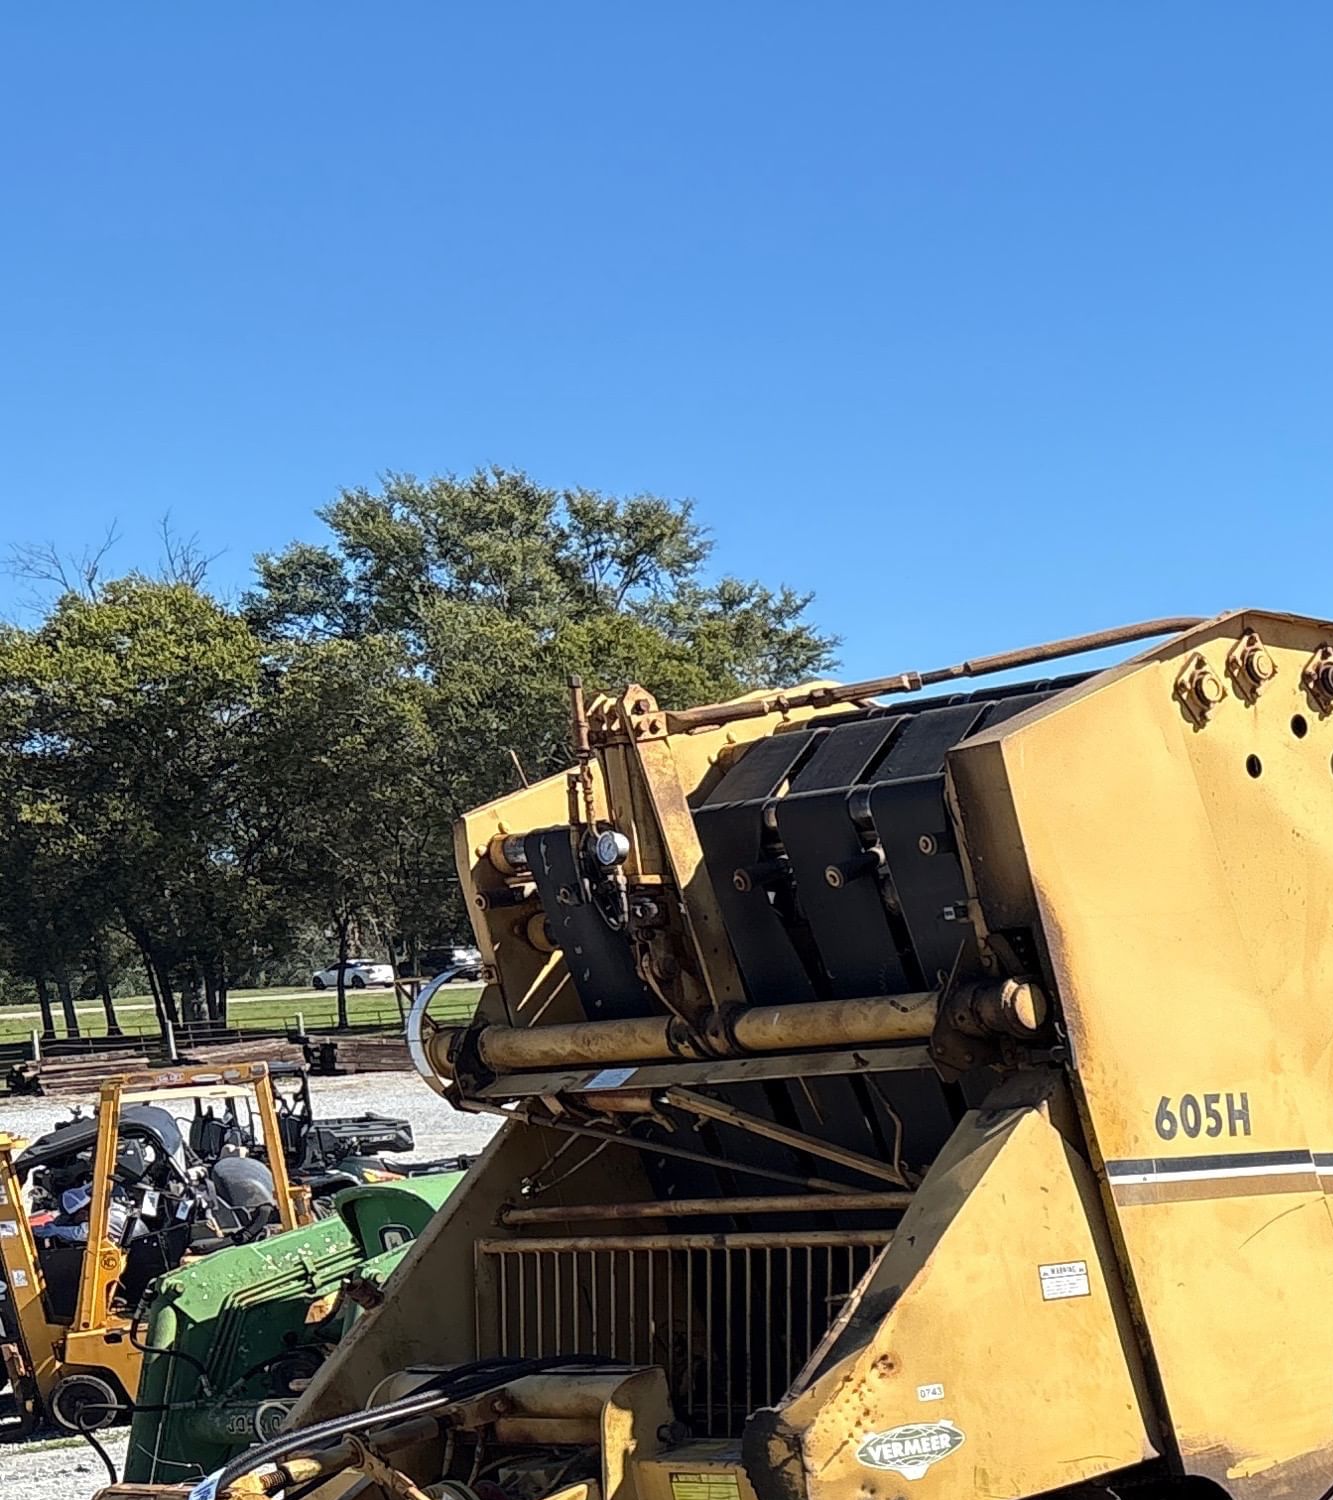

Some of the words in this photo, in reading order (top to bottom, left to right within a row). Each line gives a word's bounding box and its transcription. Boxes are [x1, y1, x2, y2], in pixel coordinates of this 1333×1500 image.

[1155, 1092, 1251, 1140] 605H
[920, 1387, 942, 1398] 0743
[867, 1433, 952, 1462] VERMEER
